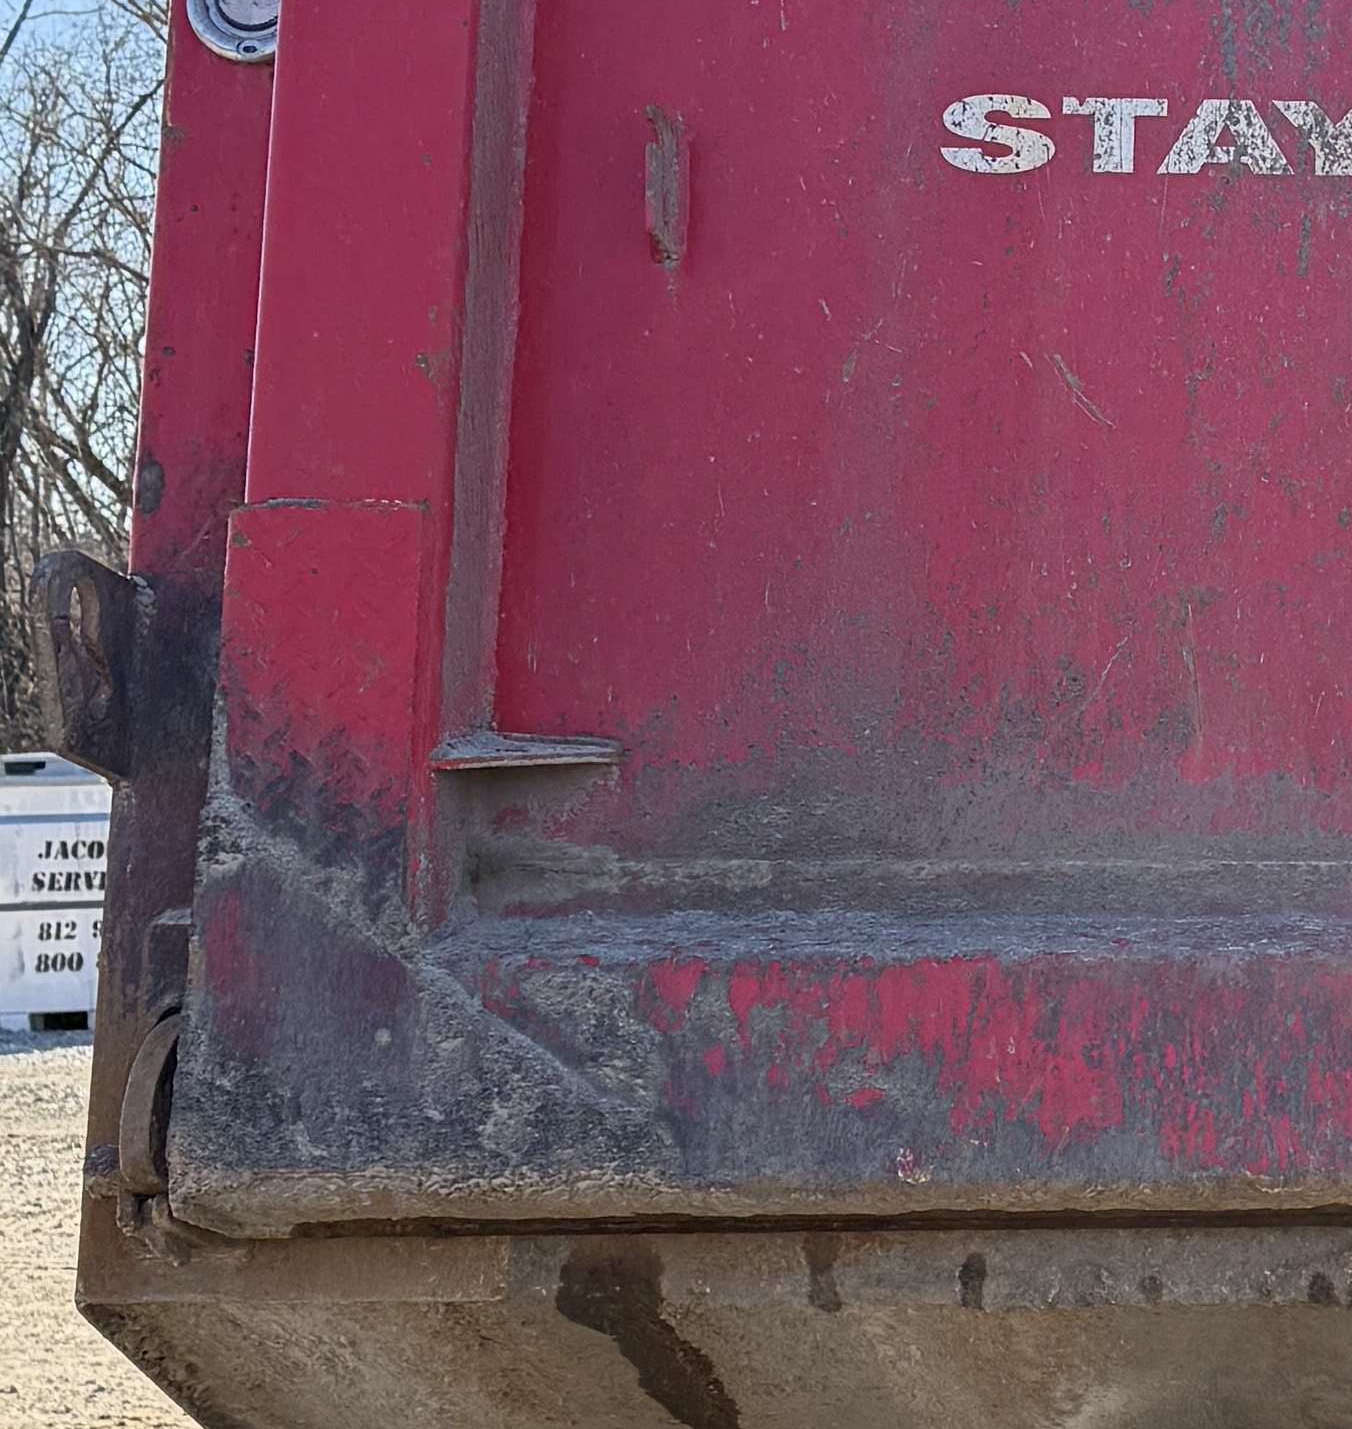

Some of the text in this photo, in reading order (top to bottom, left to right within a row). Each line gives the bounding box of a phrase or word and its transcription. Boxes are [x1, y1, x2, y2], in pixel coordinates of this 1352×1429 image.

[38, 840, 104, 859] JACO
[38, 920, 77, 940] 812
[35, 952, 84, 972] 800
